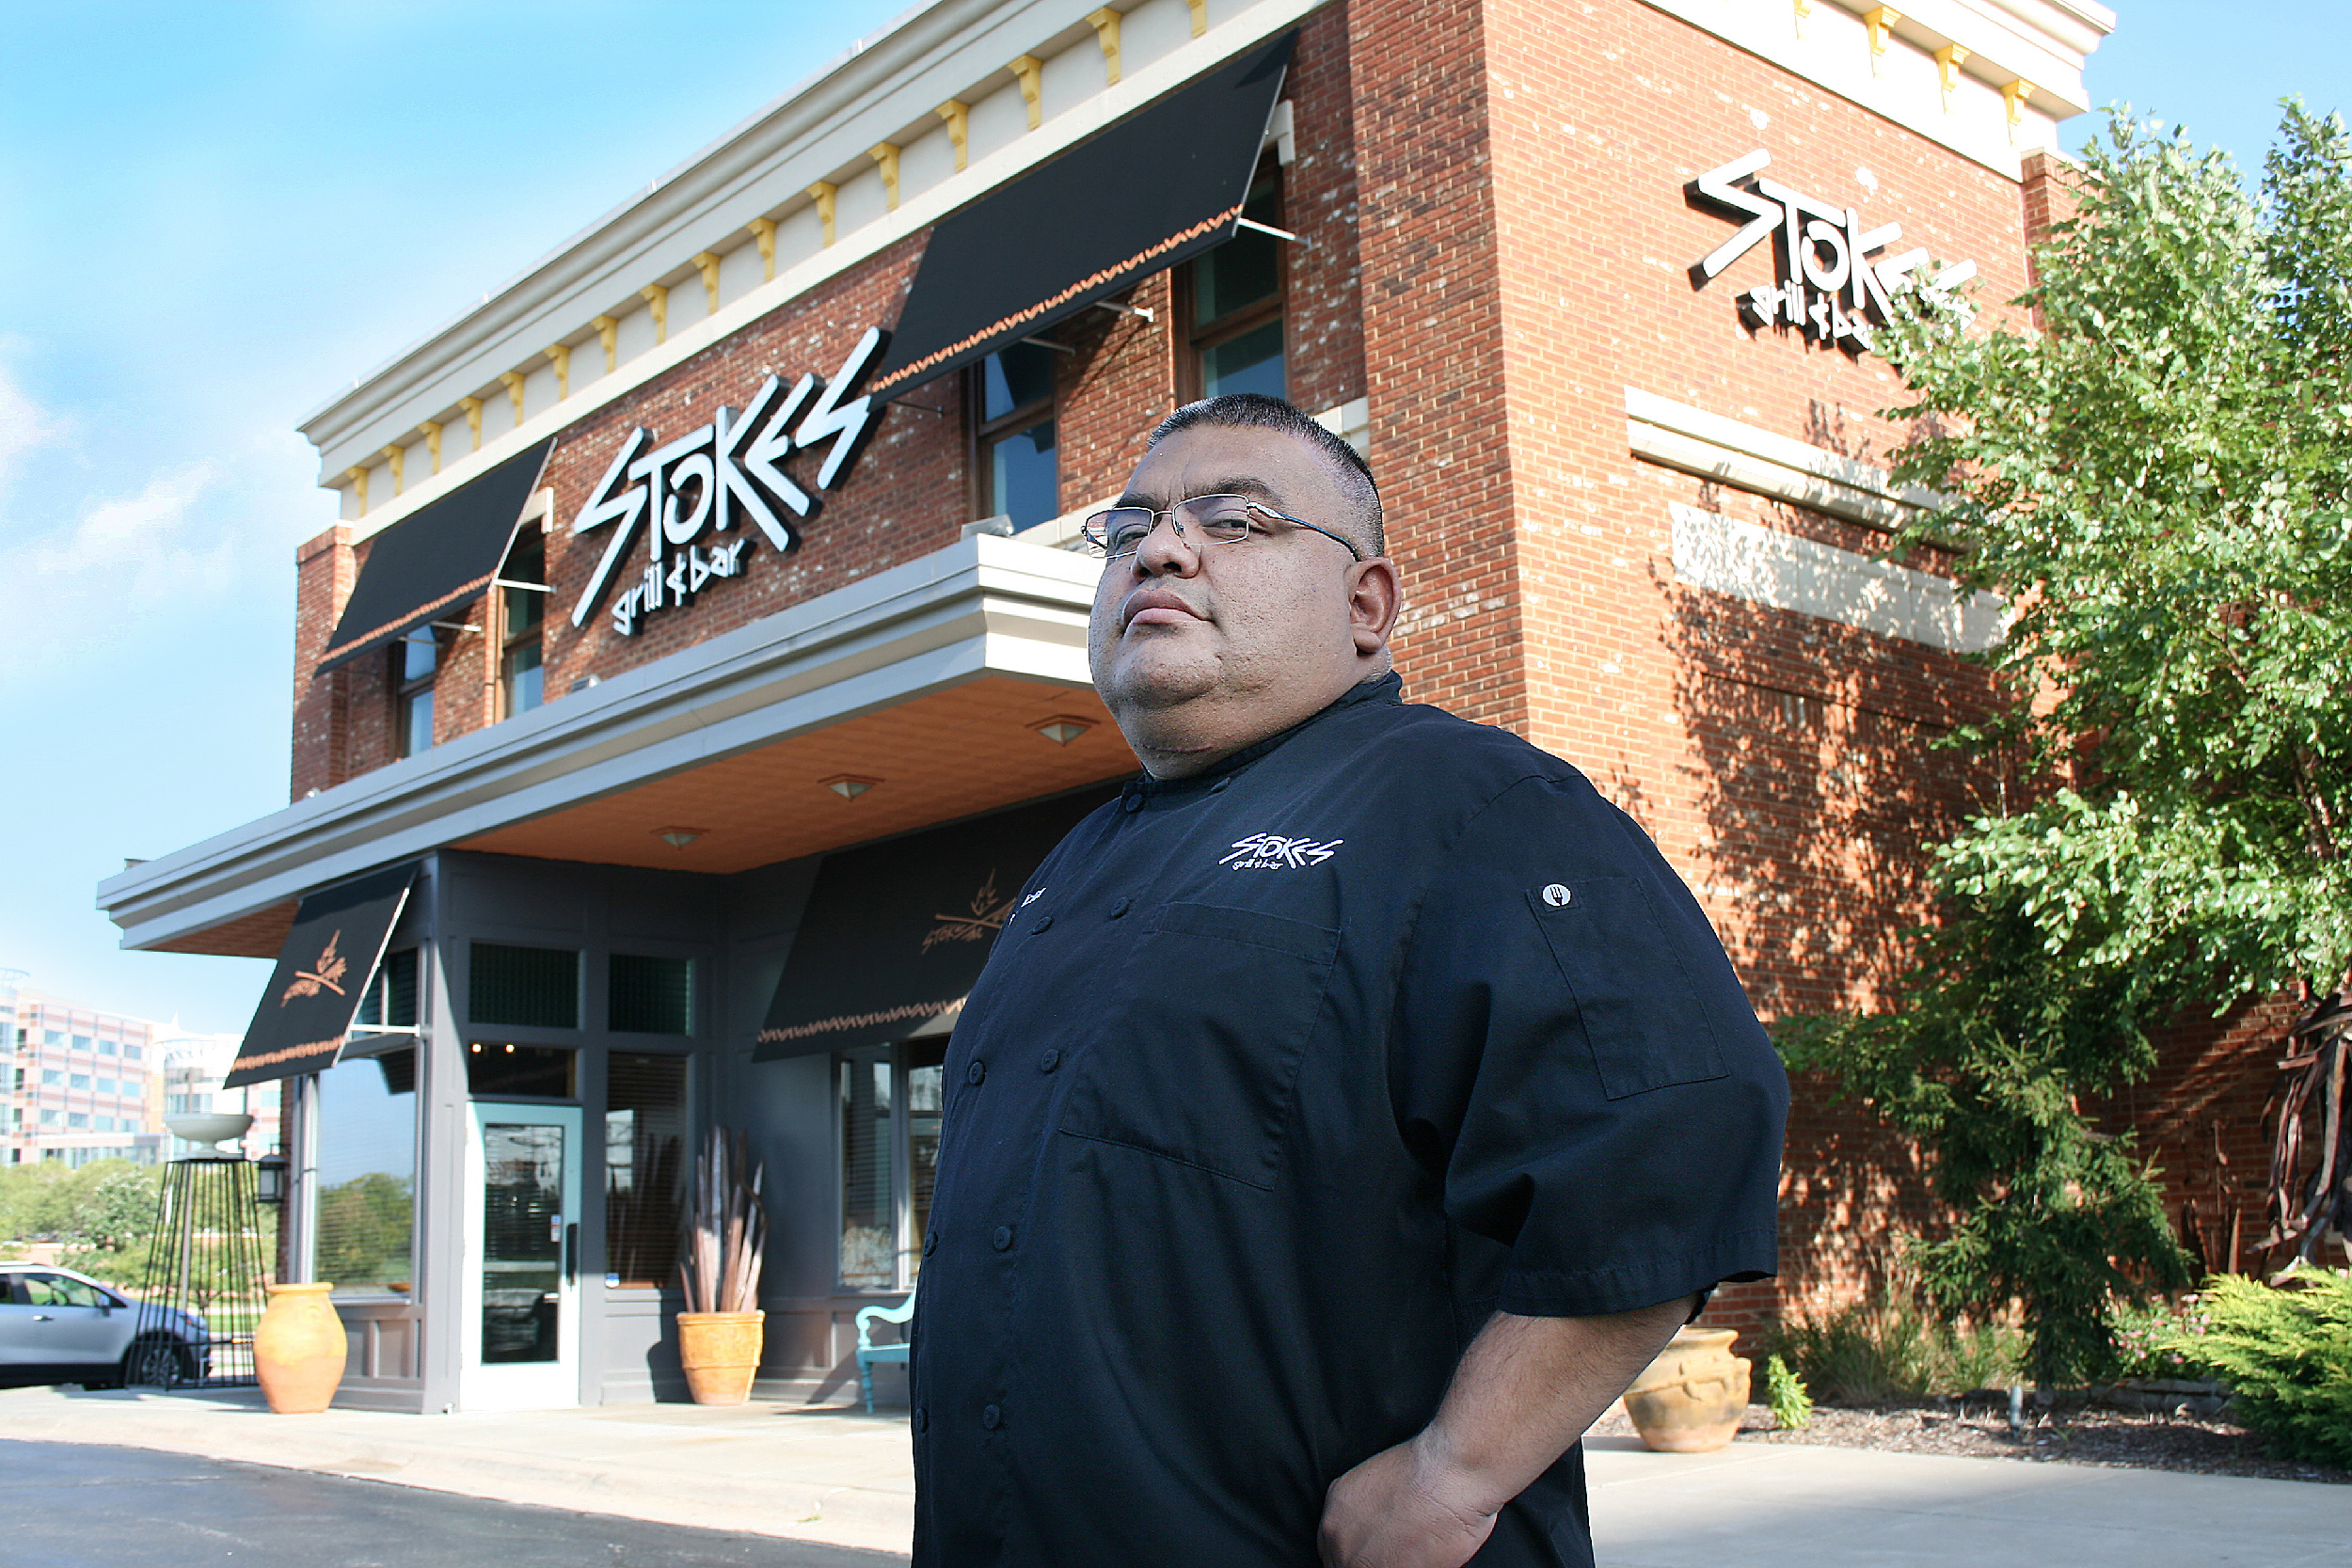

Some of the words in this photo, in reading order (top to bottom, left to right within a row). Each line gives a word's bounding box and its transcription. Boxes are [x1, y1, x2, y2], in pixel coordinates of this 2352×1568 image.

[1750, 279, 1806, 327] grill
[1832, 295, 1880, 353] ba
[571, 325, 880, 627] STOKES
[612, 562, 663, 636] grill
[690, 538, 746, 594] bar
[1217, 832, 1344, 870] STOKES
